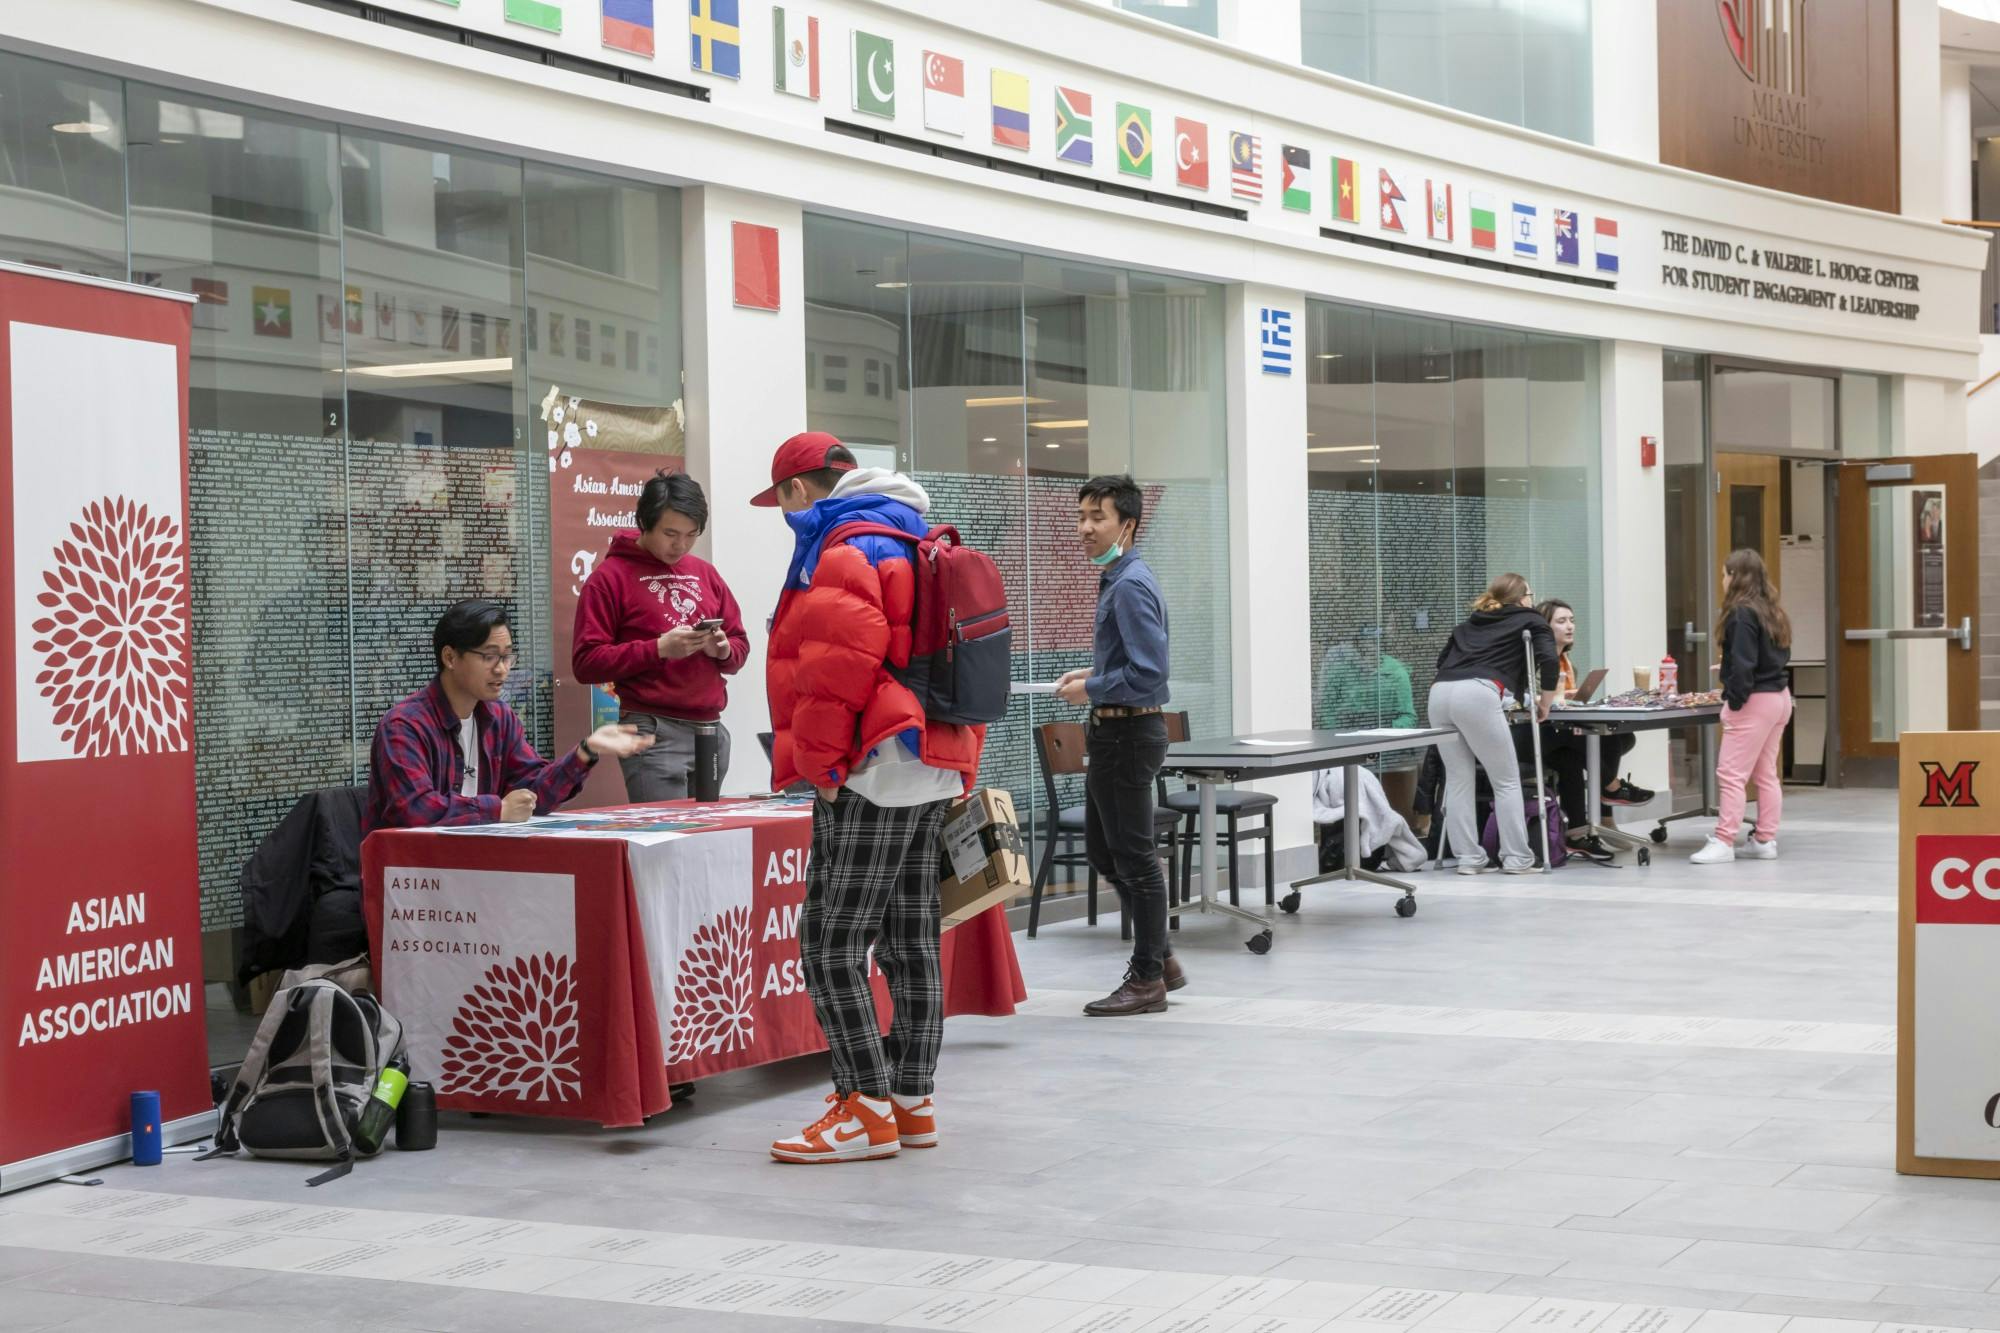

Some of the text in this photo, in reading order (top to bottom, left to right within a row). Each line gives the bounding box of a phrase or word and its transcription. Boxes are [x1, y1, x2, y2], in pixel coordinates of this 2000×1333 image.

[1752, 89, 1807, 131] MIAMI
[1733, 116, 1826, 165] UNIVERSITY
[1662, 230, 1920, 291] THE DAVID C. & VALERIE L. HODGE CENTER
[1662, 265, 1920, 320] FOR STUDENT ENGAGEMENT & LEADERSHIP
[330, 413, 337, 426] 2
[573, 473, 644, 497] Asian Ameri
[587, 507, 638, 529] Associati
[1918, 761, 1981, 807] M
[392, 877, 440, 891] ASIAN
[66, 892, 144, 934] ASIAN
[391, 909, 476, 923] AMERICAN
[36, 937, 174, 992] AMERICAN
[391, 939, 500, 956] ASSOCIATION
[18, 983, 191, 1047] ASSOCIATION
